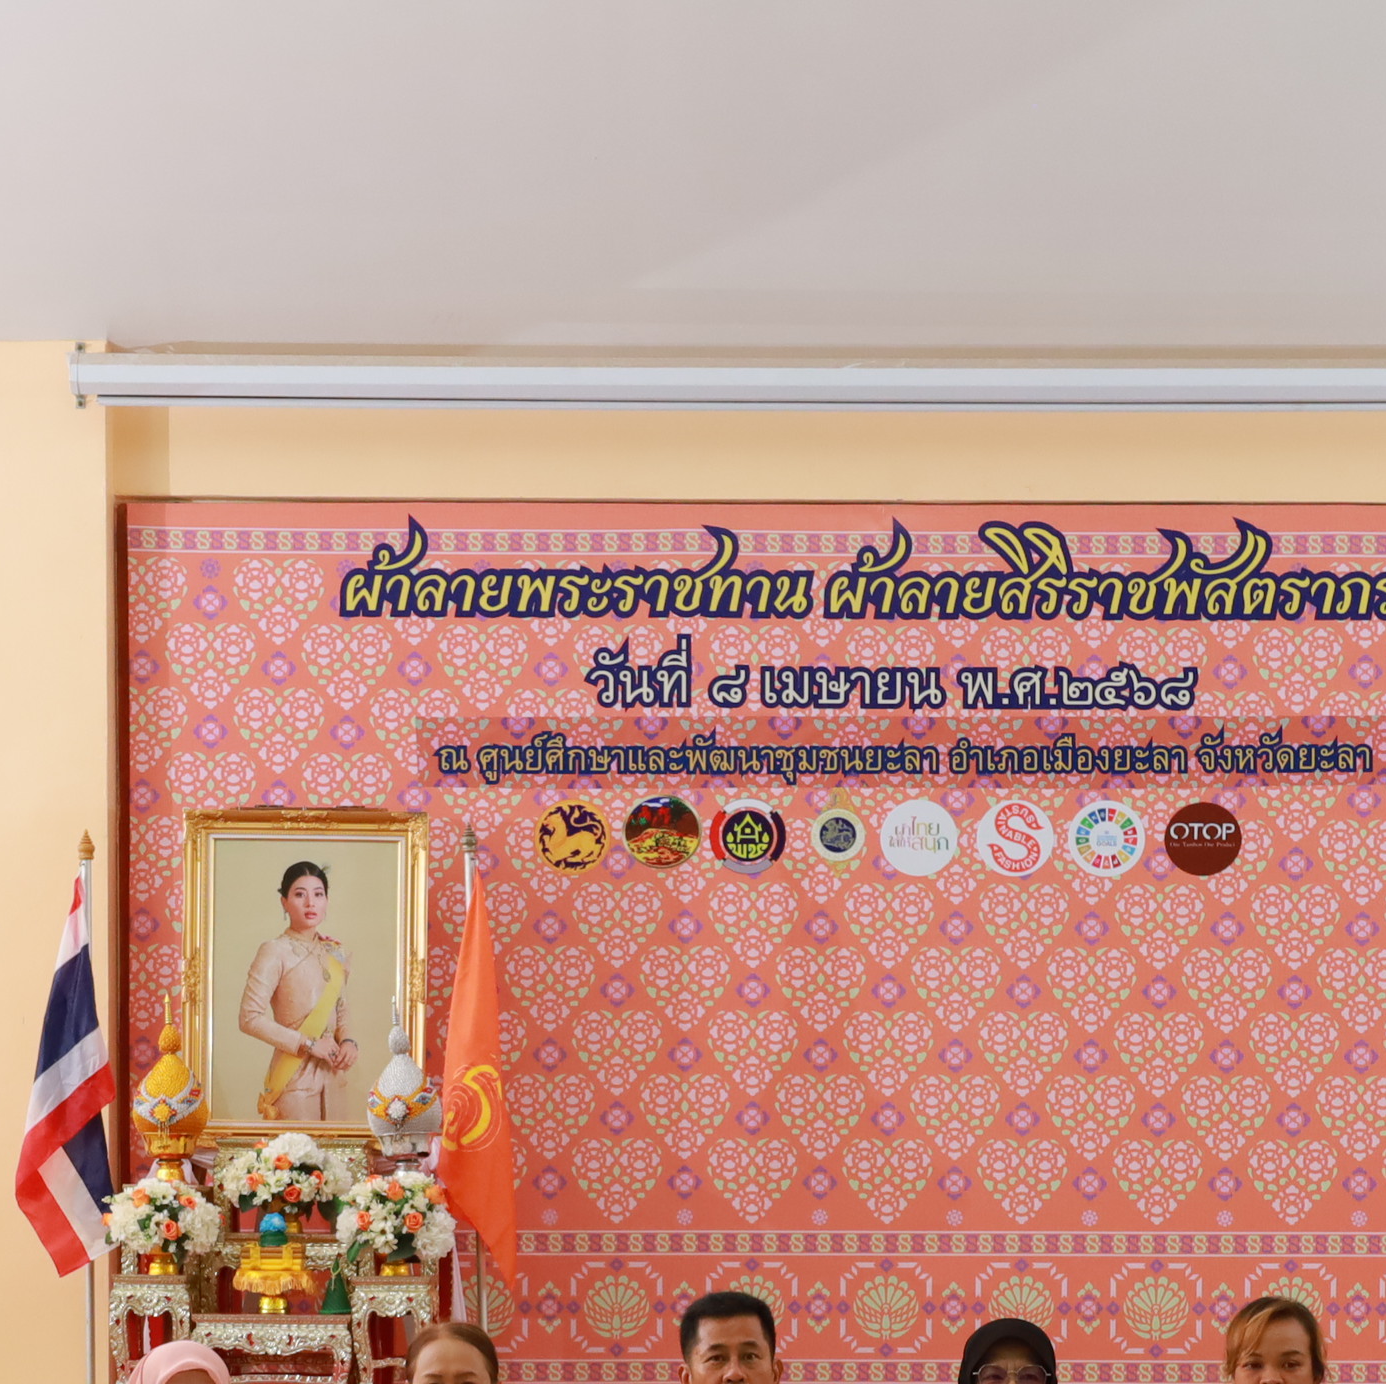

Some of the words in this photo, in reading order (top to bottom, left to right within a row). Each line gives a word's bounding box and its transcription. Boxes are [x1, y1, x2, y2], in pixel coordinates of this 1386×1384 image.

[341, 514, 813, 618] ผ้าลายพระราชทาน
[586, 635, 691, 709] วันที่
[708, 664, 749, 708] ๘
[762, 664, 943, 709] เมษายน
[959, 661, 1198, 710] พ.ศ.๒๕๖๘
[436, 744, 470, 774] ณ
[477, 730, 939, 785] ศูนย์ศึกษาและพัฒนาชุมชนยะลา
[948, 733, 1188, 777] อำเภอเมืองยะลา
[1196, 727, 1374, 776] จังหวัดยะลา
[997, 805, 1037, 849] SUSTAINABLE
[1169, 822, 1236, 841] OTOP
[994, 850, 1038, 870] FASHION
